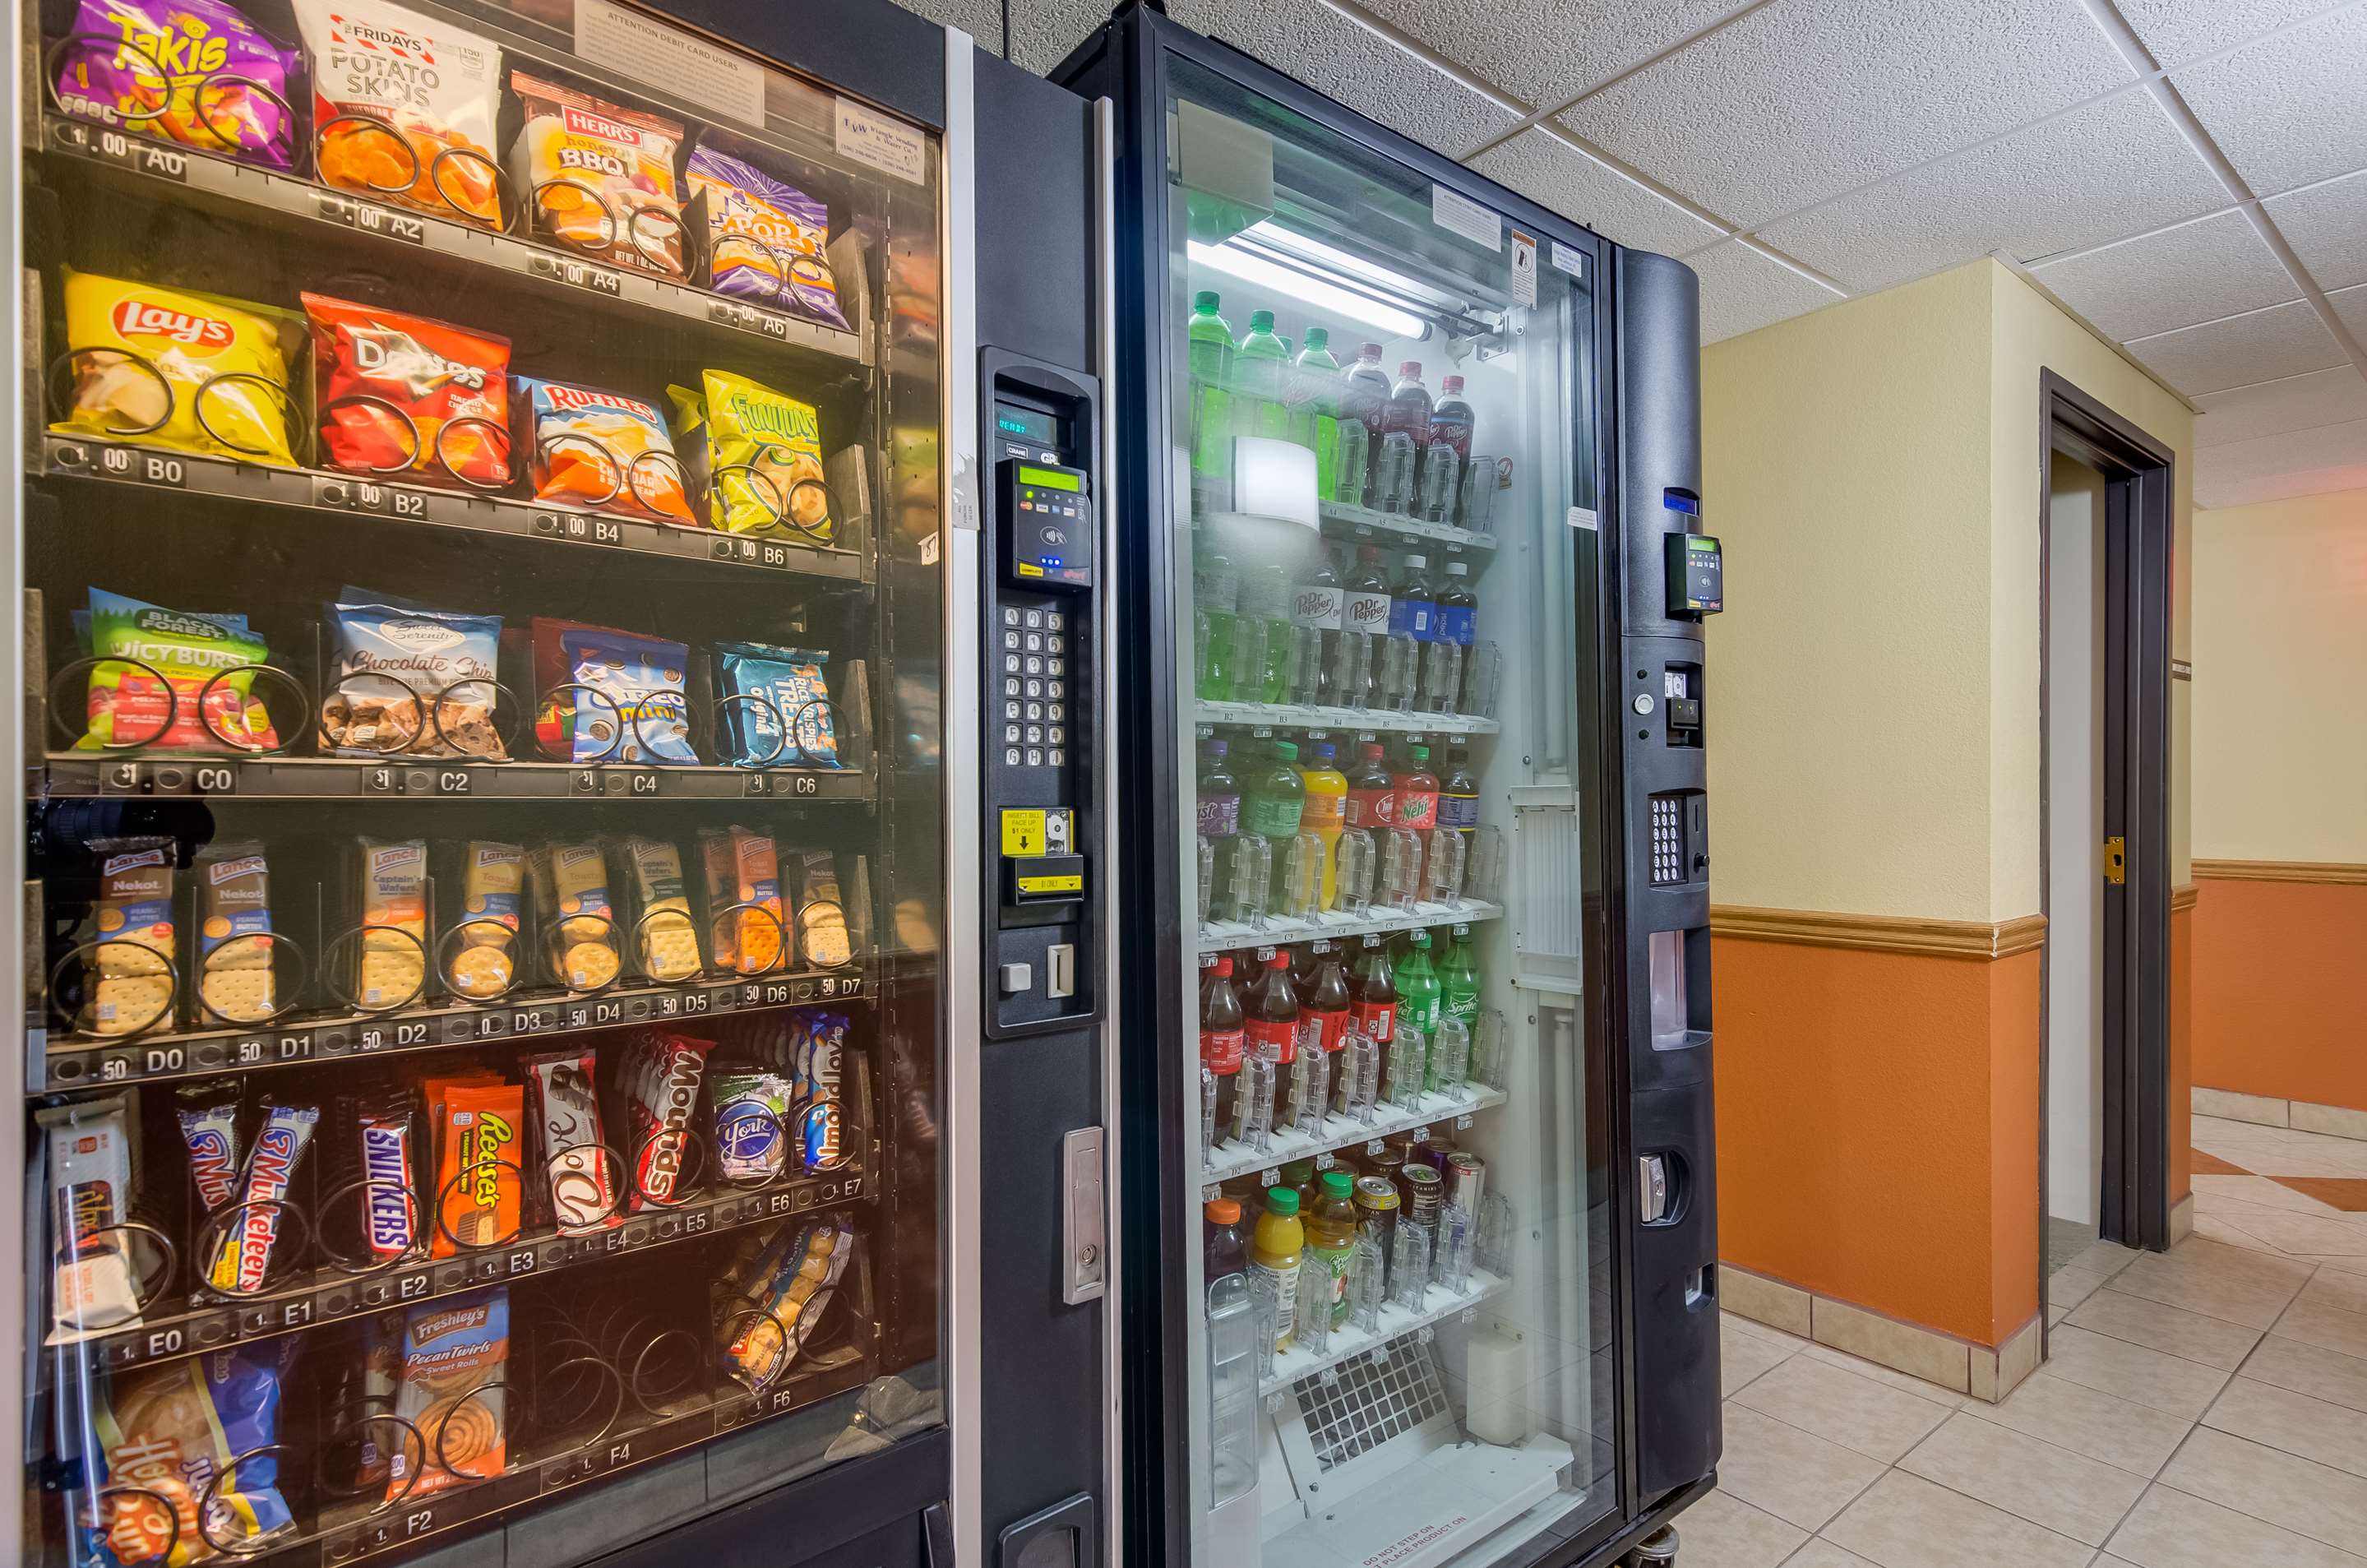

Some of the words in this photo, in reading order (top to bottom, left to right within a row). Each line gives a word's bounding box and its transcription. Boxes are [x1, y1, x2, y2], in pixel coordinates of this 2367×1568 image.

[108, 12, 228, 74] Takis
[354, 26, 422, 52] FRIDAYS
[608, 12, 659, 39] ATTENTION
[660, 33, 685, 49] DEBIT
[687, 44, 710, 60] CARD
[712, 55, 738, 72] USERS
[330, 47, 440, 90] POTATO
[346, 74, 430, 107] SKINS
[566, 136, 617, 156] honey
[147, 148, 183, 174] A0
[561, 148, 626, 177] BBQ
[391, 219, 420, 238] A2
[594, 271, 617, 290] A4
[121, 302, 231, 344] Lay's
[764, 317, 785, 335] A6
[546, 386, 657, 423] RUFFLES
[732, 394, 819, 441] FUNYUNS
[147, 458, 182, 483] B0
[395, 494, 423, 516] B2
[596, 525, 618, 542] B4
[765, 548, 784, 565] B6
[1296, 598, 1332, 617] Pepper
[1352, 604, 1386, 622] Pepper
[1364, 599, 1379, 611] Dr
[141, 618, 224, 640] FOREST
[148, 610, 219, 631] BLACK
[393, 630, 454, 643] Serenity
[110, 641, 175, 663] JUICY
[177, 649, 251, 670] BURST
[351, 650, 448, 673] Chocolate
[455, 656, 495, 681] Chip
[621, 704, 677, 725] mini
[197, 769, 232, 790] C0
[441, 773, 468, 792] C2
[635, 775, 657, 793] C4
[797, 778, 816, 793] C6
[375, 848, 418, 867] Lance
[113, 880, 159, 890] Nekot
[373, 874, 422, 885] Captain's
[379, 883, 418, 893] Wafers
[220, 889, 264, 900] Nekot
[768, 987, 787, 1002] D6
[843, 979, 861, 994] D7
[597, 1004, 620, 1021] D4
[686, 995, 706, 1012] D5
[1449, 1001, 1477, 1014] Sprite
[515, 1012, 540, 1031] D3
[398, 1024, 426, 1044] D2
[281, 1036, 310, 1057] D1
[147, 1049, 183, 1071] D0
[647, 1051, 704, 1196] Mounds
[720, 1110, 775, 1161] York
[474, 1112, 512, 1209] Reese's
[366, 1130, 408, 1247] SNICKERS
[845, 1178, 862, 1195] E7
[772, 1195, 789, 1212] E6
[238, 1152, 290, 1292] Musketeers
[687, 1214, 706, 1232] E5
[607, 1231, 627, 1251] E4
[511, 1252, 534, 1273] E3
[401, 1277, 427, 1298] E2
[285, 1302, 310, 1324] E1
[416, 1308, 485, 1339] Freshley's
[150, 1330, 182, 1355] E0
[427, 1363, 454, 1375] Sweet
[456, 1358, 478, 1370] Rolls
[774, 1390, 790, 1409] F6
[610, 1443, 630, 1465] F4
[408, 1510, 432, 1535] F2
[1362, 1554, 1378, 1566] DO
[1377, 1544, 1397, 1561] NOT
[1398, 1532, 1420, 1548] STEP
[1420, 1524, 1435, 1536] ON
[1383, 1548, 1413, 1568] PLACE
[1412, 1523, 1453, 1549] PRODUCT
[1453, 1515, 1468, 1529] ON
